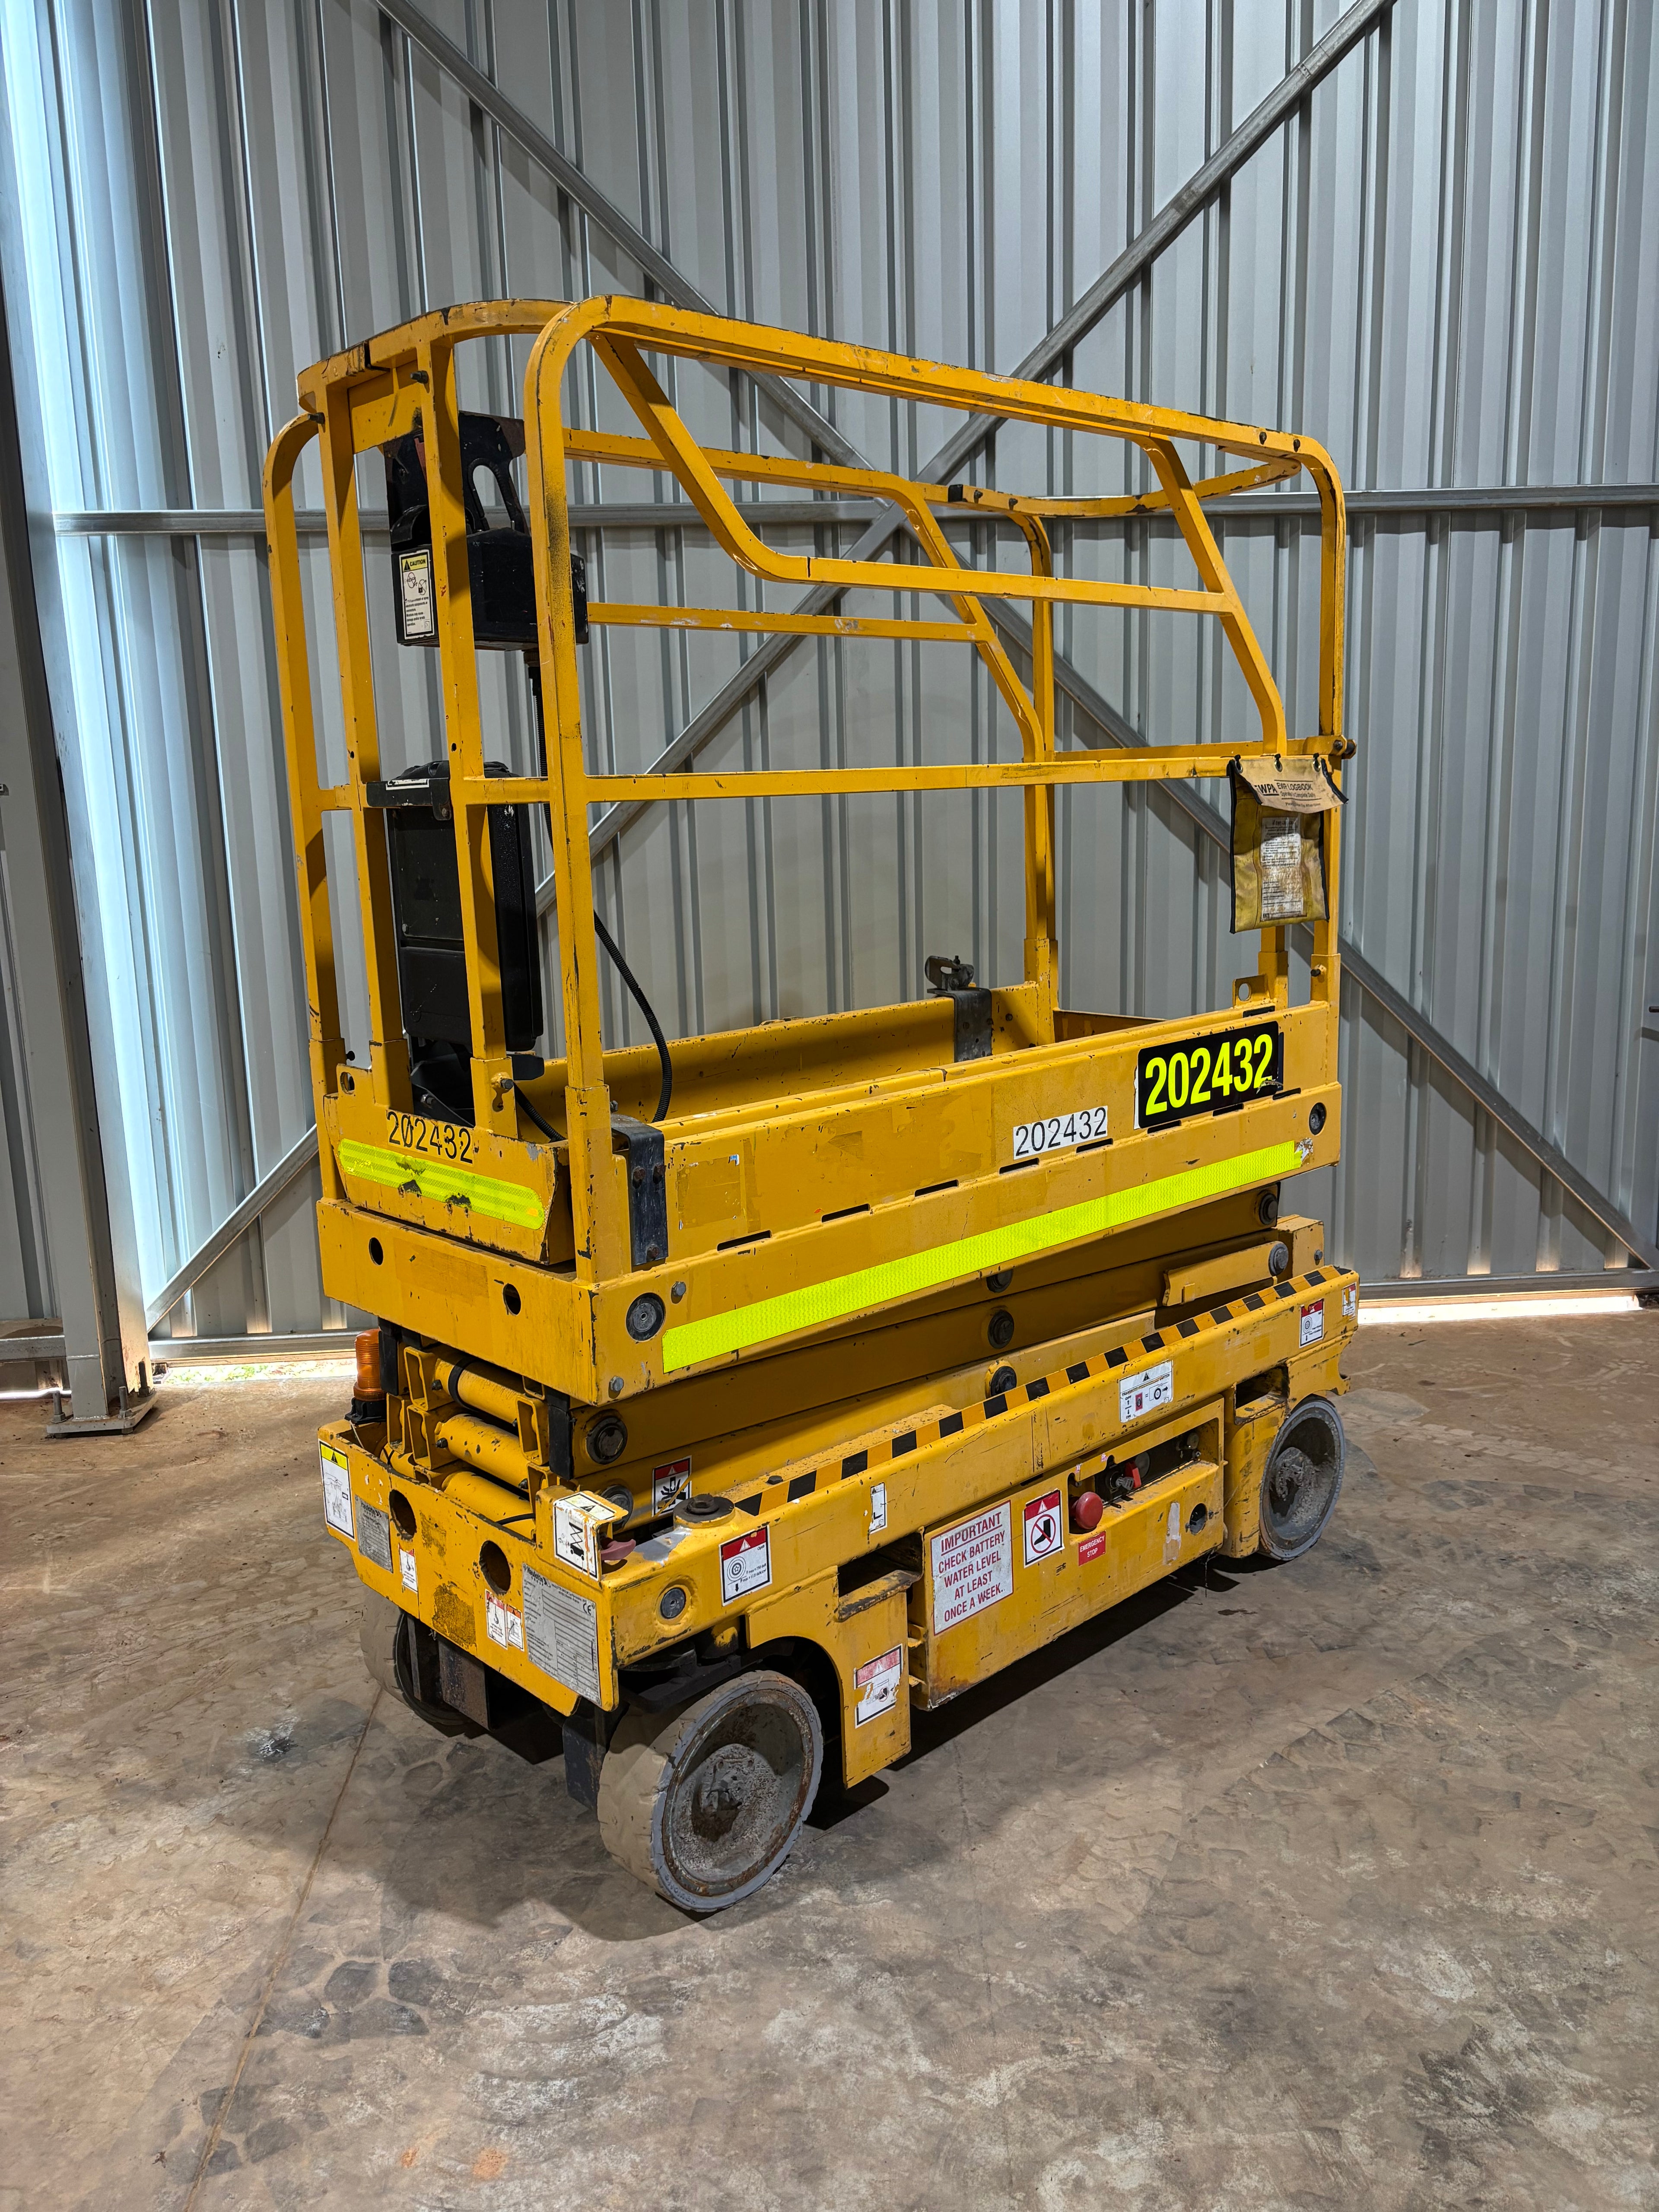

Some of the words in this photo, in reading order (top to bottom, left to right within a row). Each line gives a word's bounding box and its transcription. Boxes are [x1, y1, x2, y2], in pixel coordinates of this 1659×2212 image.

[1254, 784, 1278, 794] WPA
[1145, 1034, 1273, 1116] 202432
[387, 1111, 473, 1163] 202432
[1015, 1107, 1106, 1157] 202432
[939, 1549, 966, 1573] CHECK
[969, 1530, 1005, 1558] BATTERY
[941, 1512, 1001, 1552] IMPORTANT
[1080, 1535, 1105, 1553] EMERGENCY
[944, 1564, 974, 1588] WATER
[976, 1551, 1001, 1572] LEVEL
[1087, 1548, 1098, 1557] STOP
[944, 1601, 967, 1622] ONCE
[969, 1597, 975, 1610] A
[978, 1583, 1003, 1603] WEEK.
[954, 1585, 964, 1600] AT
[967, 1570, 992, 1593] LEAST
